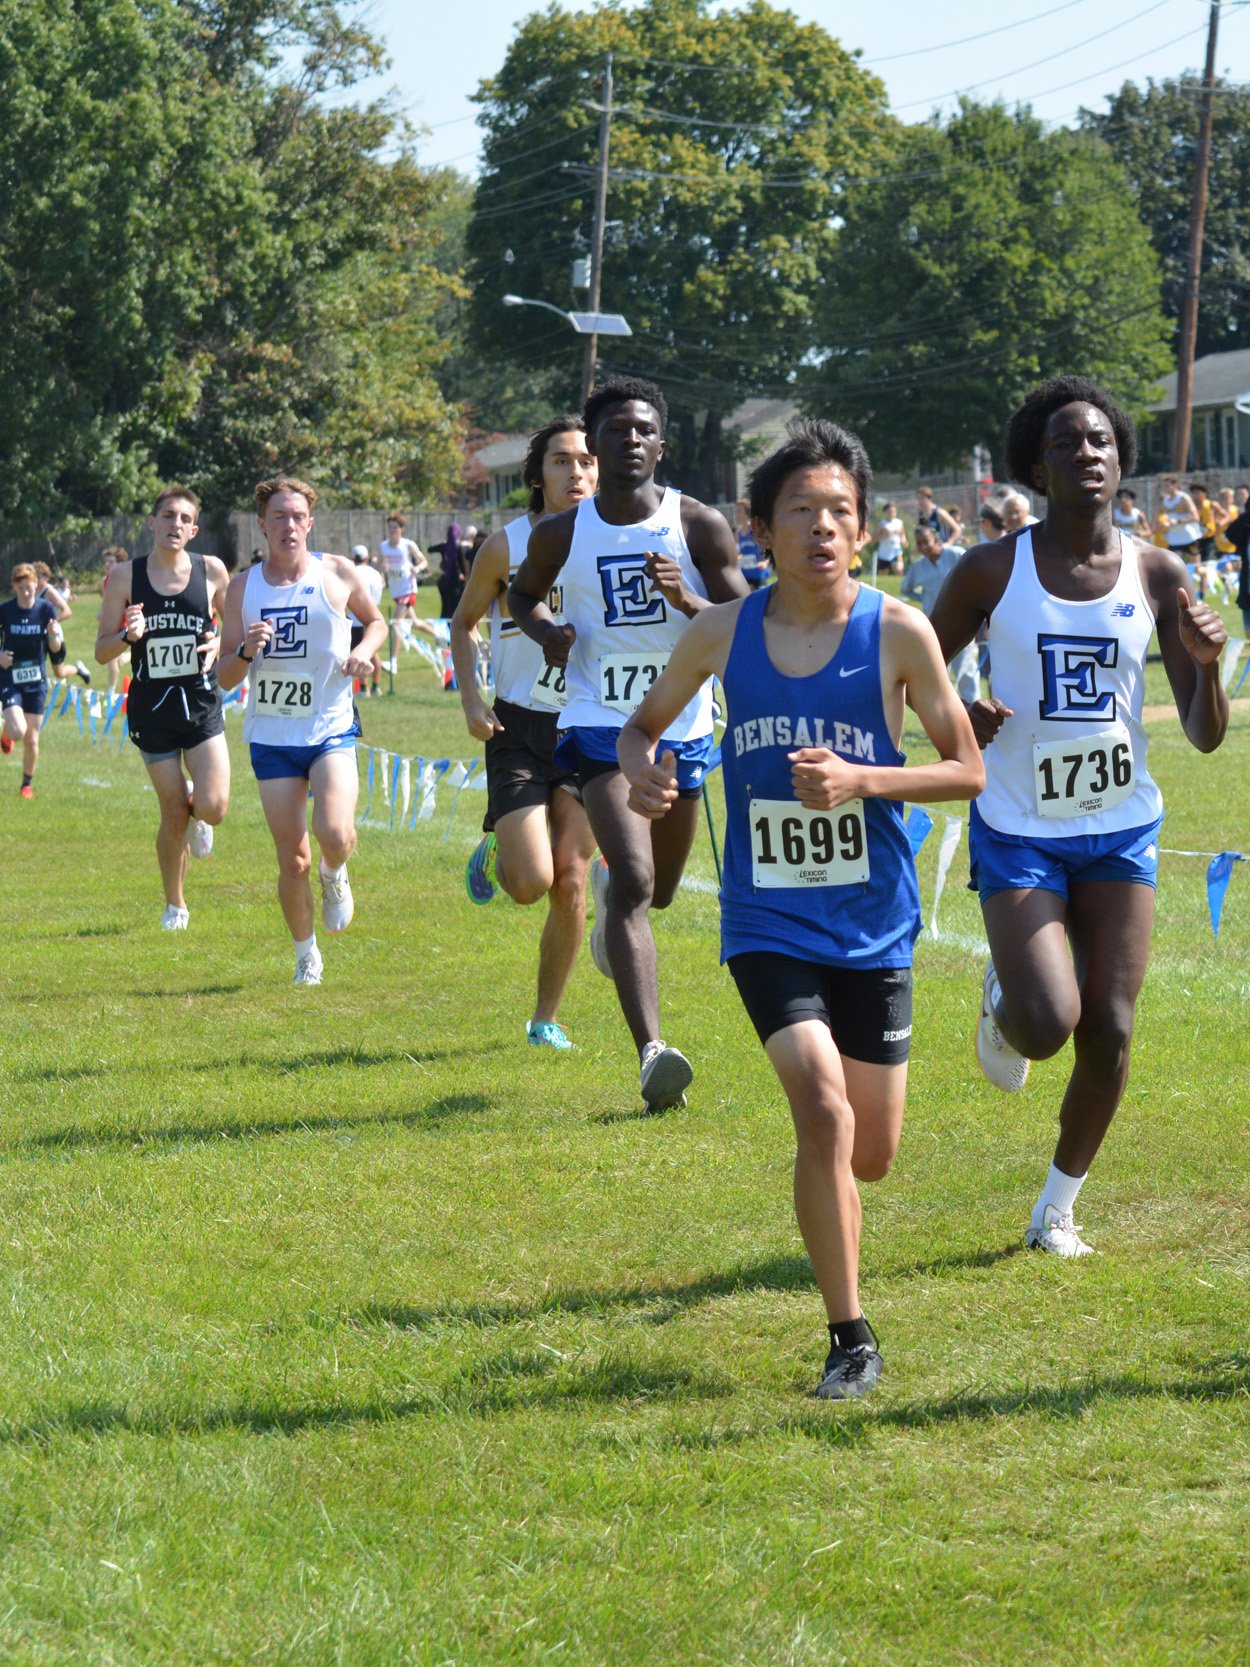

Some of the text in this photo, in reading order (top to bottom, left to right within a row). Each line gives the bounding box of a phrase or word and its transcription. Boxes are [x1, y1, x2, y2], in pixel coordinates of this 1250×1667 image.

[596, 552, 667, 628] E
[149, 643, 194, 668] 1707
[261, 606, 308, 659] E
[258, 679, 312, 707] 1728
[604, 664, 667, 701] 173
[1037, 633, 1118, 722] E
[733, 715, 876, 762] BENSALEM
[1038, 743, 1132, 801] 1736
[755, 813, 864, 866] 1699
